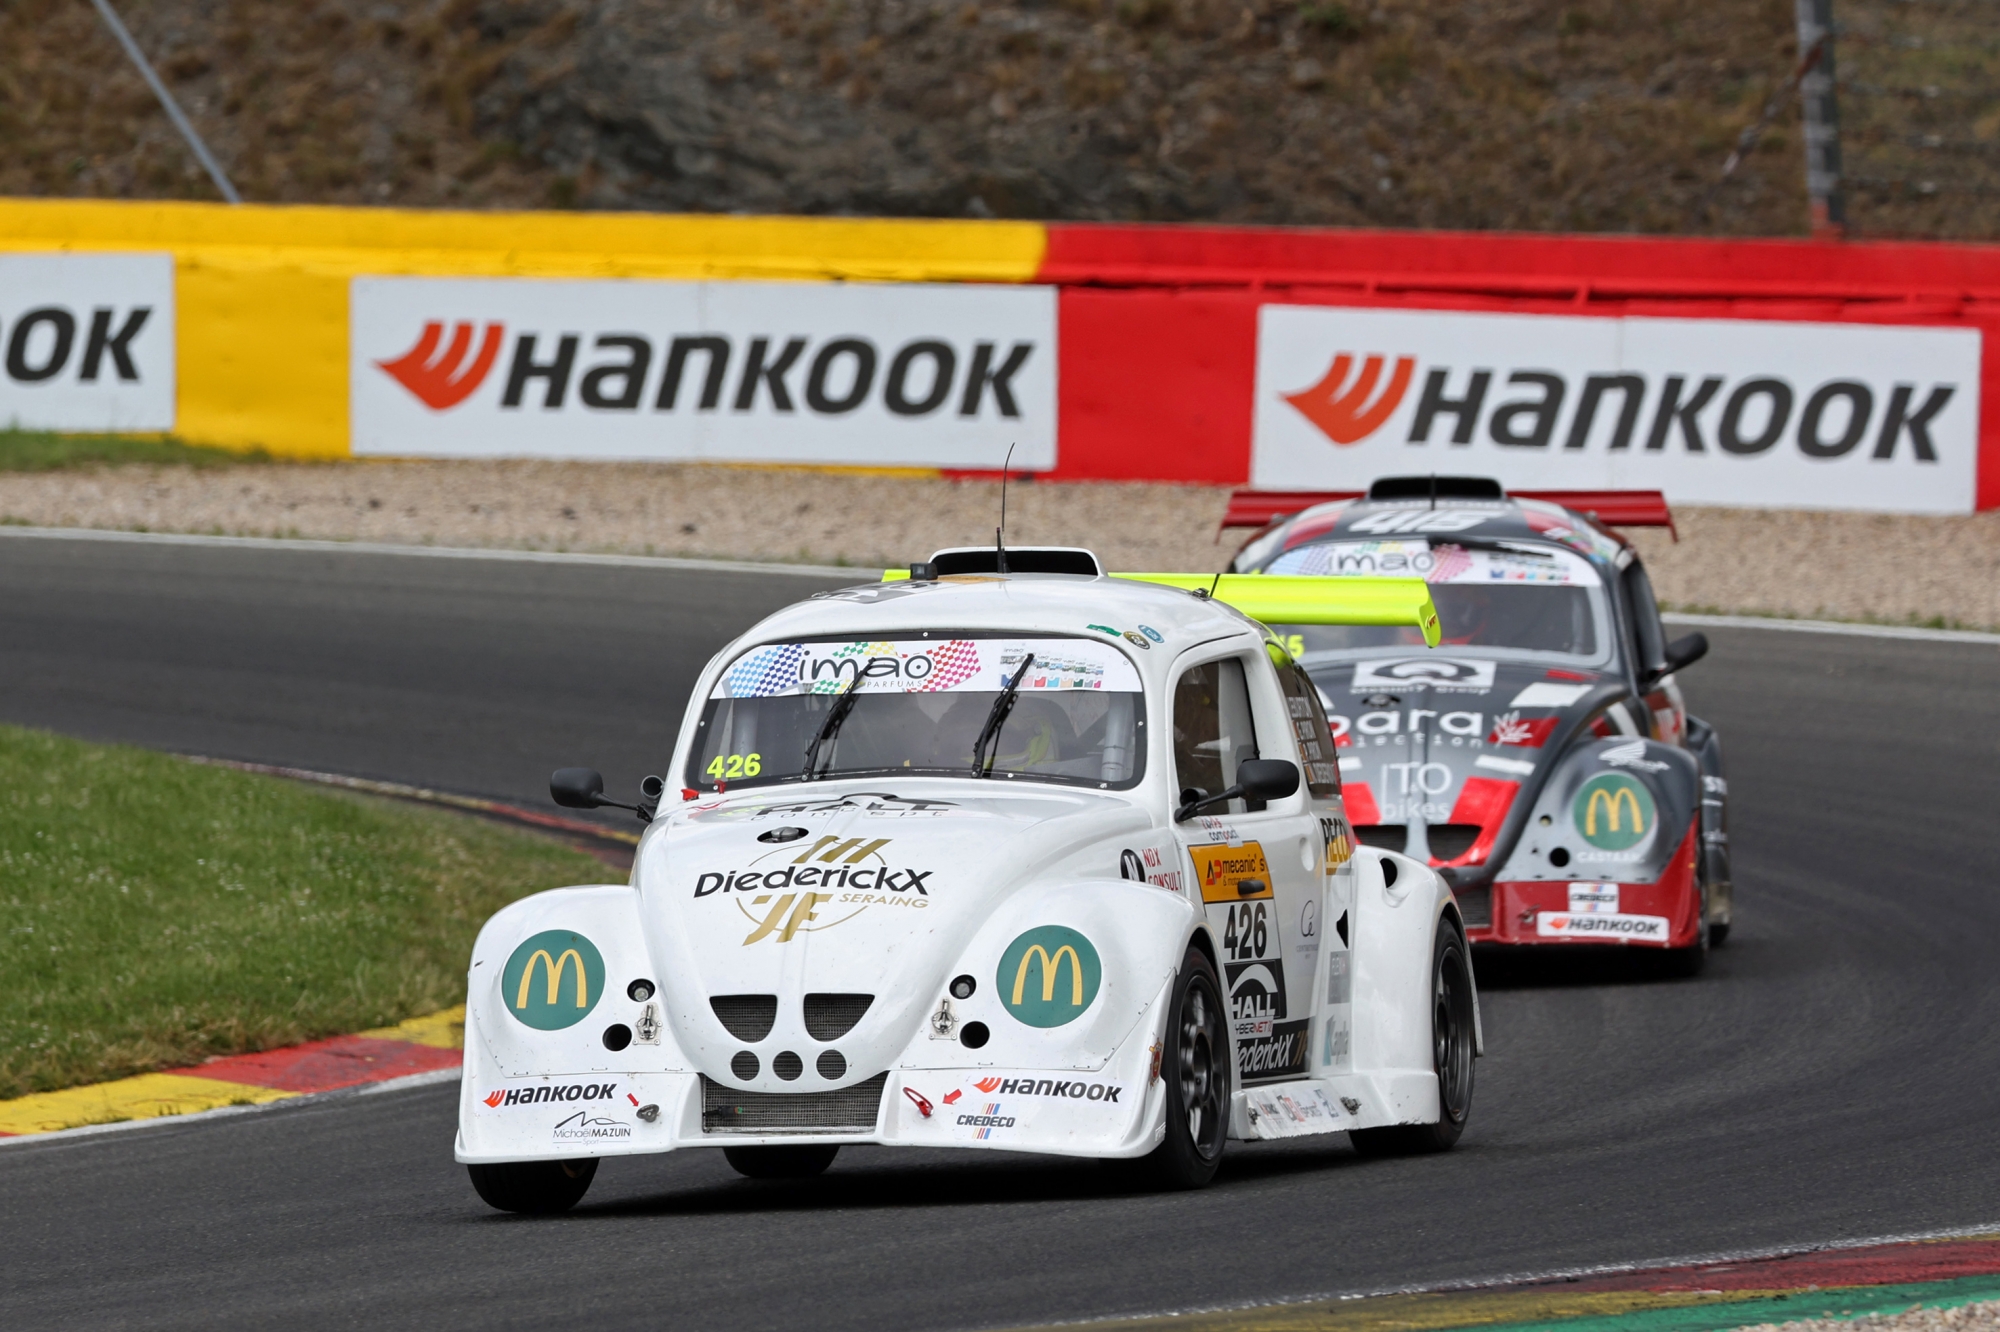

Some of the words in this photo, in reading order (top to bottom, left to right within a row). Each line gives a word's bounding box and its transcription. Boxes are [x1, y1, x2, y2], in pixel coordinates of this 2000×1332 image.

[800, 650, 932, 681] imao
[867, 680, 923, 689] PARFUMS
[706, 753, 762, 779] 426
[1142, 847, 1162, 868] NDX
[1148, 871, 1182, 891] CONSULT
[839, 893, 929, 909] SERAING
[1223, 902, 1267, 960] 426
[1231, 994, 1276, 1020] HALL
[1235, 1021, 1269, 1035] YBERNET
[956, 1114, 1016, 1128] CREDECO
[582, 1138, 600, 1146] Sport
